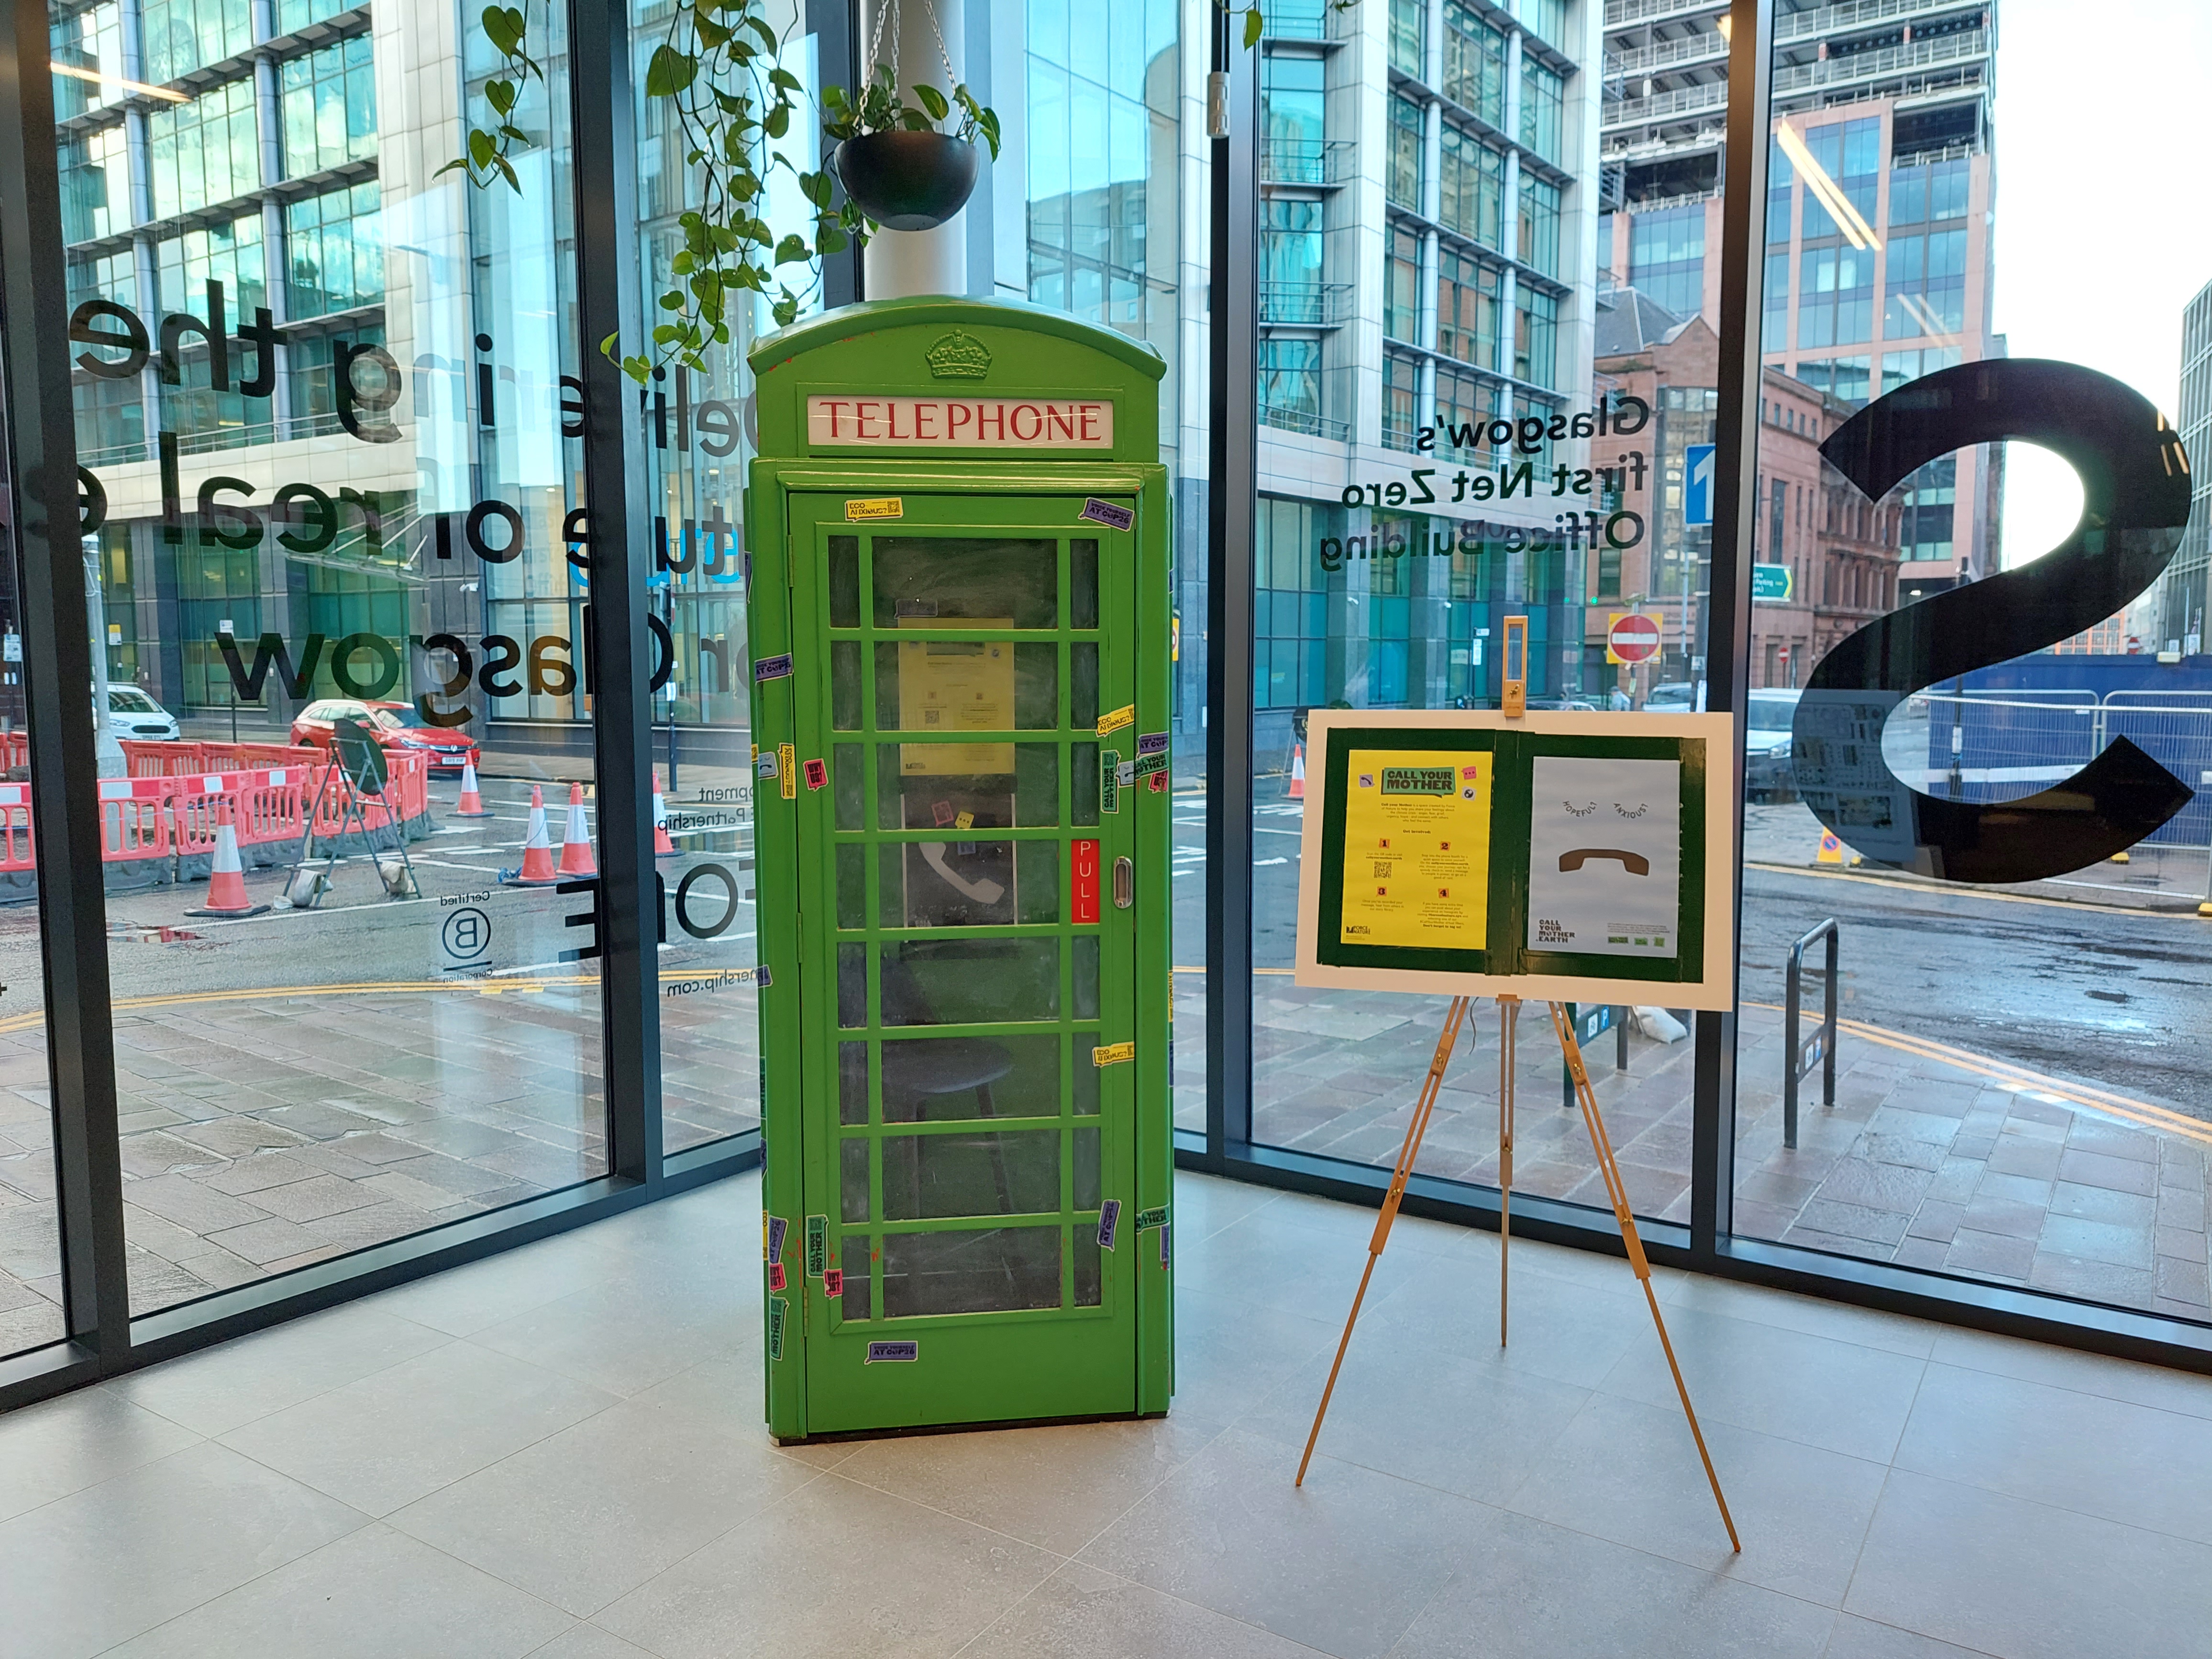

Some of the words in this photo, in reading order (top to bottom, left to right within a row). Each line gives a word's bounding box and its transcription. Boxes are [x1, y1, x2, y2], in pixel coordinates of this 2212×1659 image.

[819, 401, 1102, 441] TELEPHONE
[1387, 771, 1417, 779] CALL
[1419, 771, 1452, 780] YOUR
[1387, 779, 1453, 790] MOTHER
[1563, 801, 1597, 817] HOPEFUL?
[1613, 803, 1648, 819] ANXIOUS?
[1079, 841, 1091, 918] PULL
[1439, 889, 1447, 897] 4
[772, 1314, 781, 1354] MOTHER
